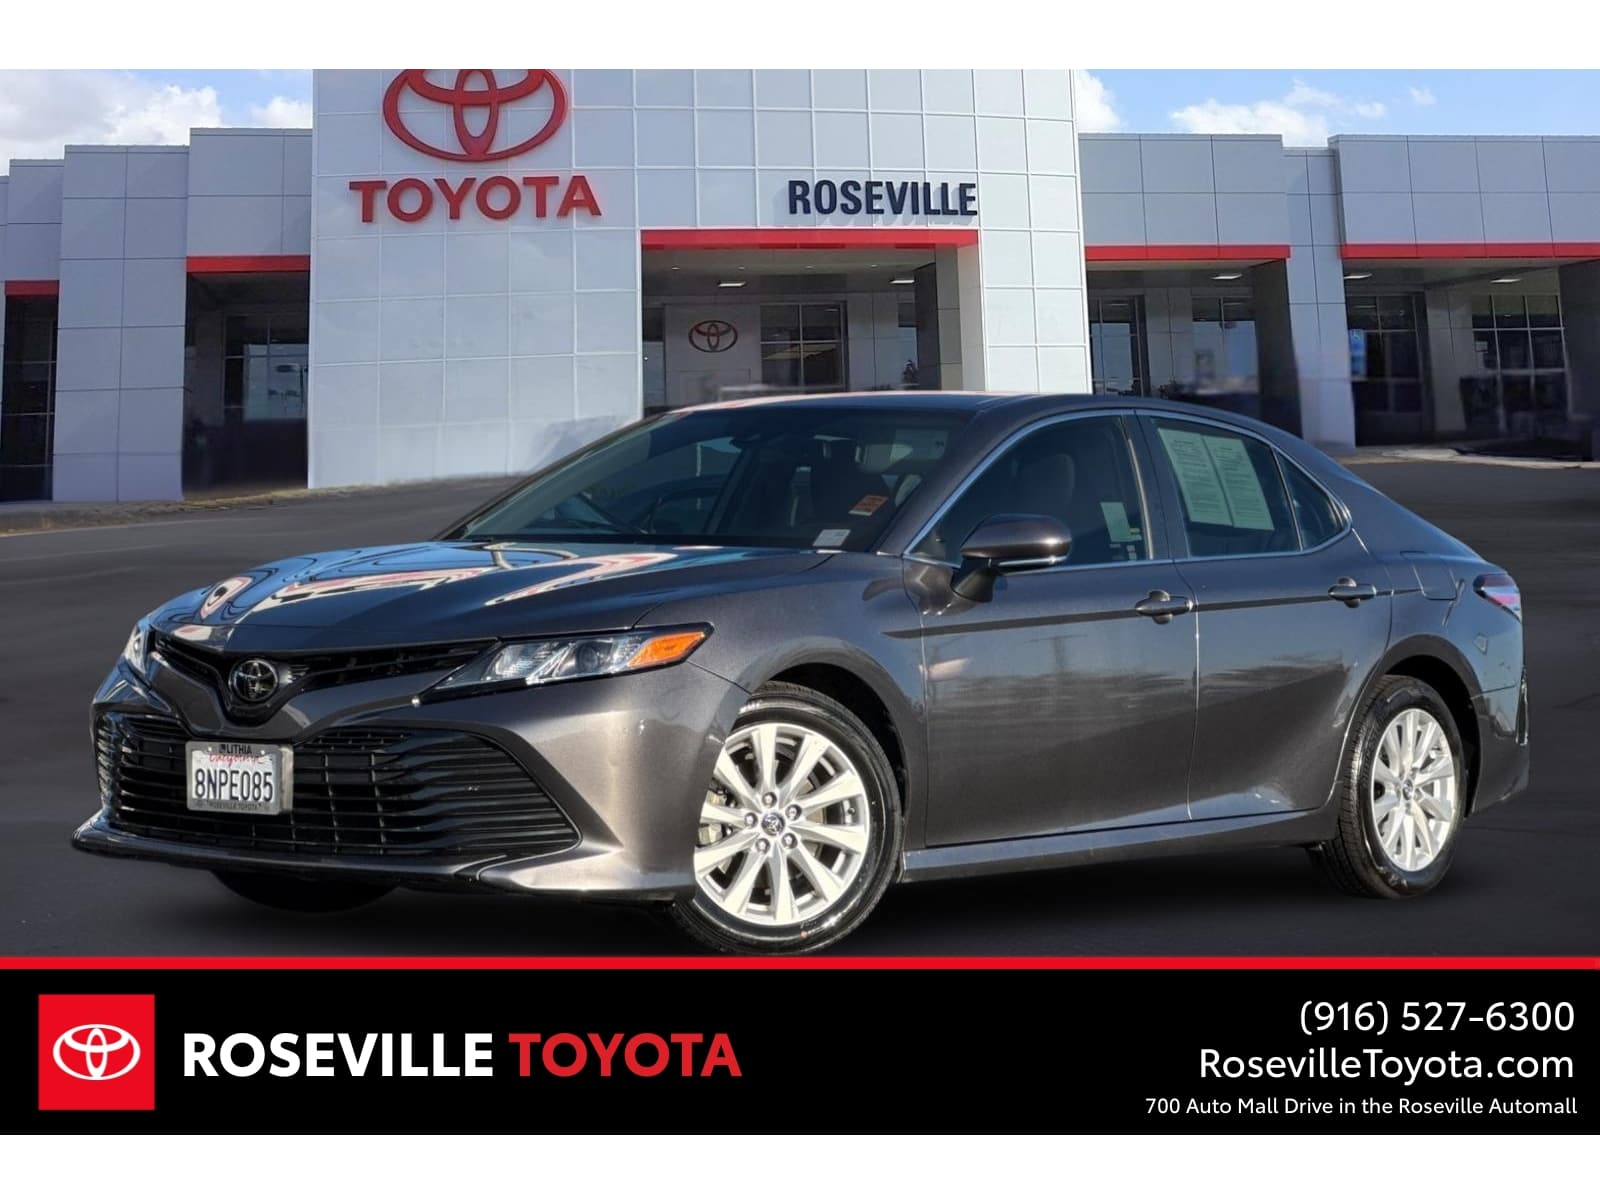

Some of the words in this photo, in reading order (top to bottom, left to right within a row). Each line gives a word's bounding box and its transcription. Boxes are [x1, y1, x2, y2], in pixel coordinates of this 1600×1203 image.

[349, 175, 602, 223] TOYOTA
[788, 180, 979, 216] ROSEVILLE
[226, 744, 253, 754] LITHIA
[194, 768, 274, 802] 8NPE085
